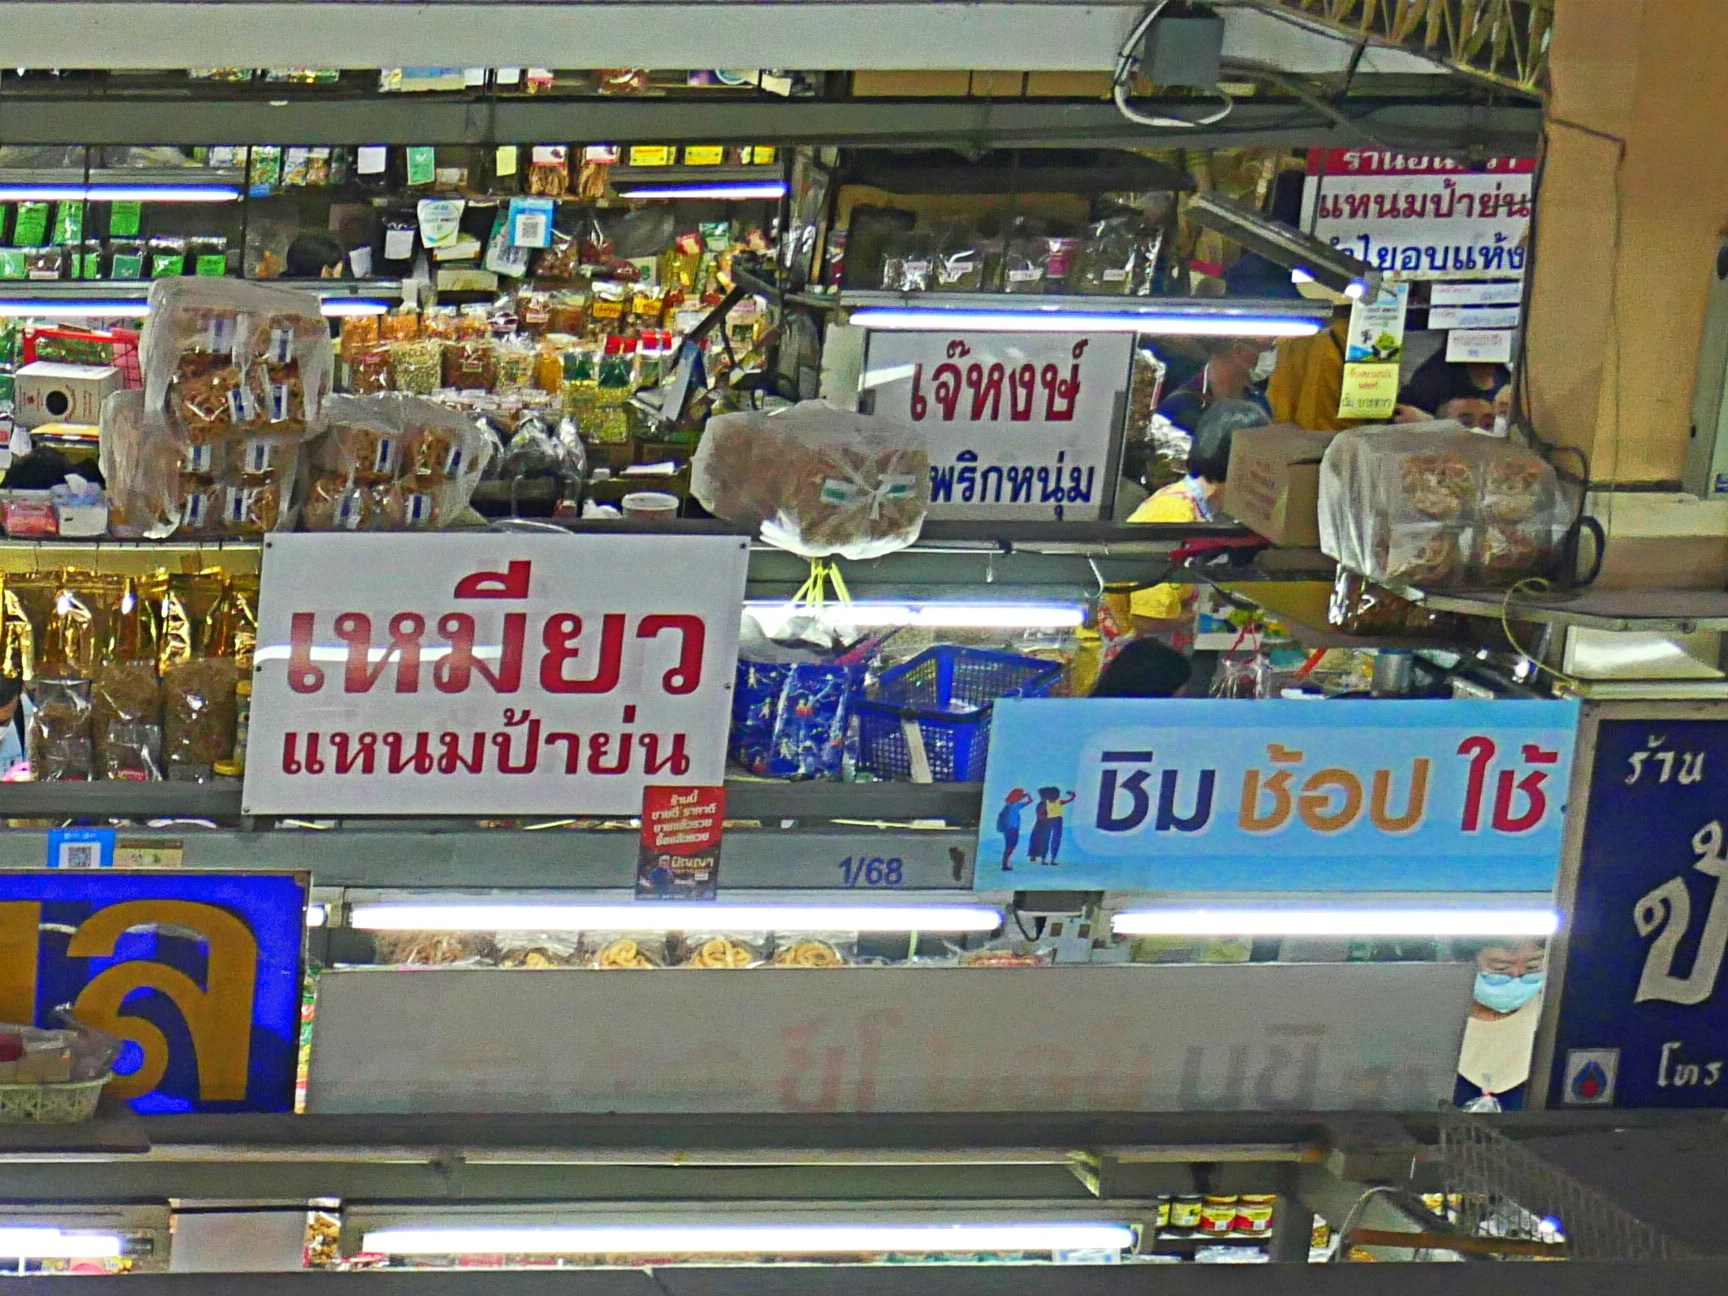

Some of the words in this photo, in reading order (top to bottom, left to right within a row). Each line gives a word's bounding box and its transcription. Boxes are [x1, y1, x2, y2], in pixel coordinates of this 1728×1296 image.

[910, 338, 1090, 422] เจ๊หงษ์
[929, 449, 1095, 521] พริกหนุ่ม
[286, 559, 706, 695] เหมียว
[281, 703, 691, 776] แหนมป้าย่น
[1625, 734, 1706, 786] ร้าน
[1093, 750, 1217, 834] ชิม
[1237, 744, 1432, 834] ช้อป
[1454, 735, 1559, 835] ใช้
[837, 856, 906, 887] 1/68
